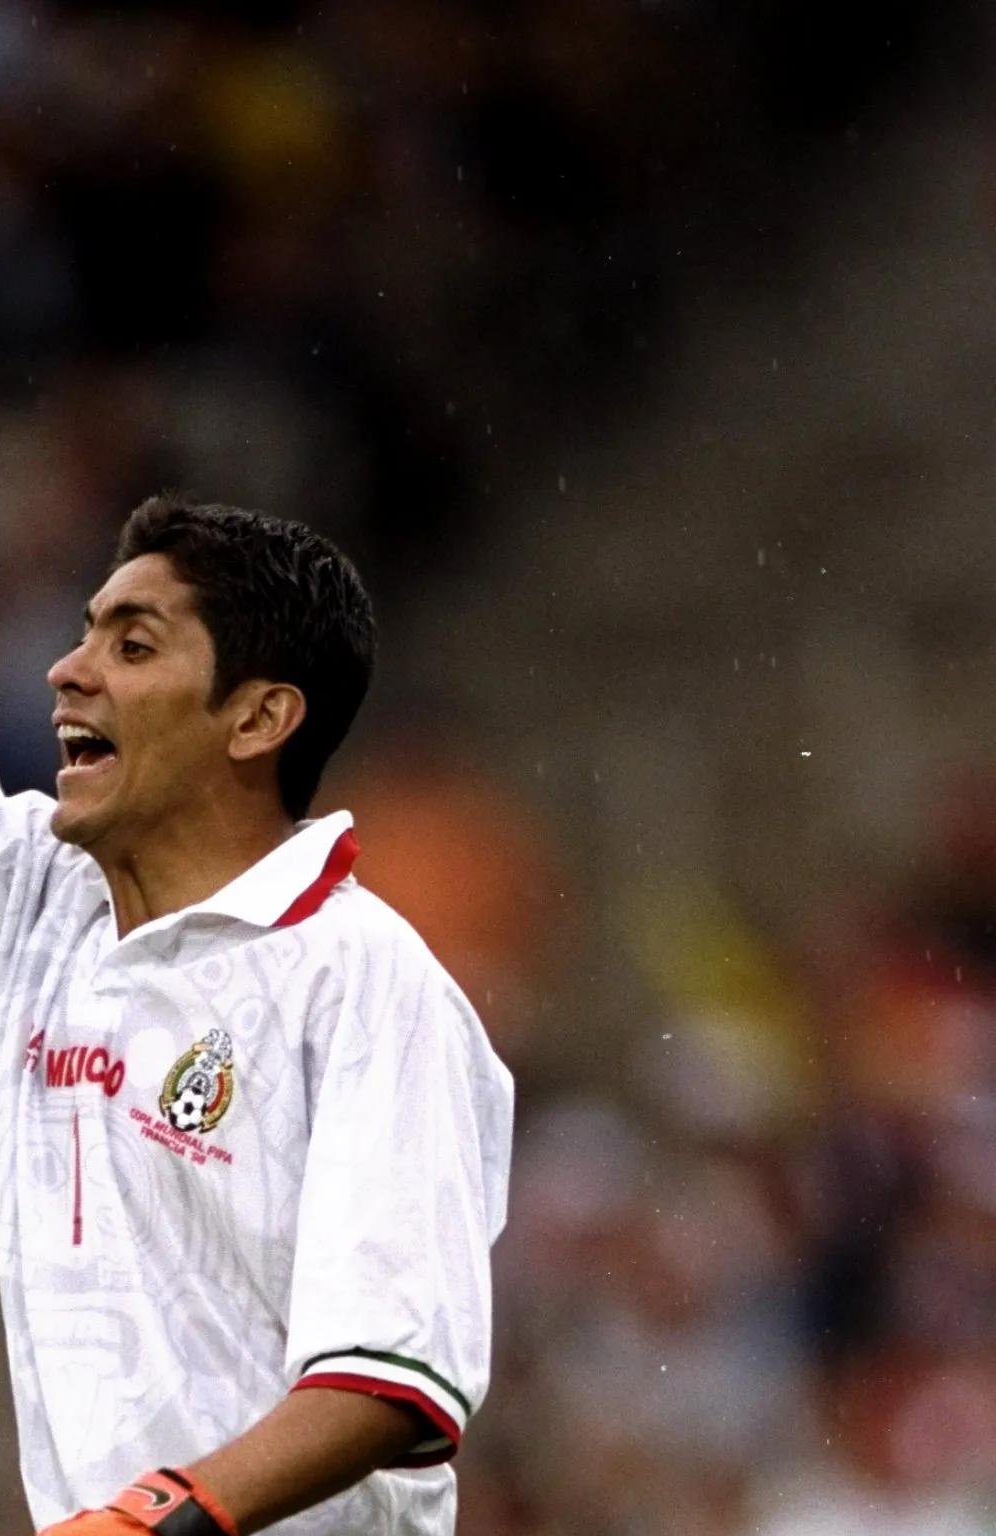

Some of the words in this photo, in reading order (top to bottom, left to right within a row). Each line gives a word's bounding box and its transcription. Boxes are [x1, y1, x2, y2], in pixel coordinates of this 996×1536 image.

[46, 1046, 125, 1097] MICO
[129, 1107, 153, 1126] COPA
[152, 1120, 204, 1153] MUNDIAL
[140, 1126, 186, 1157] FRANCIA
